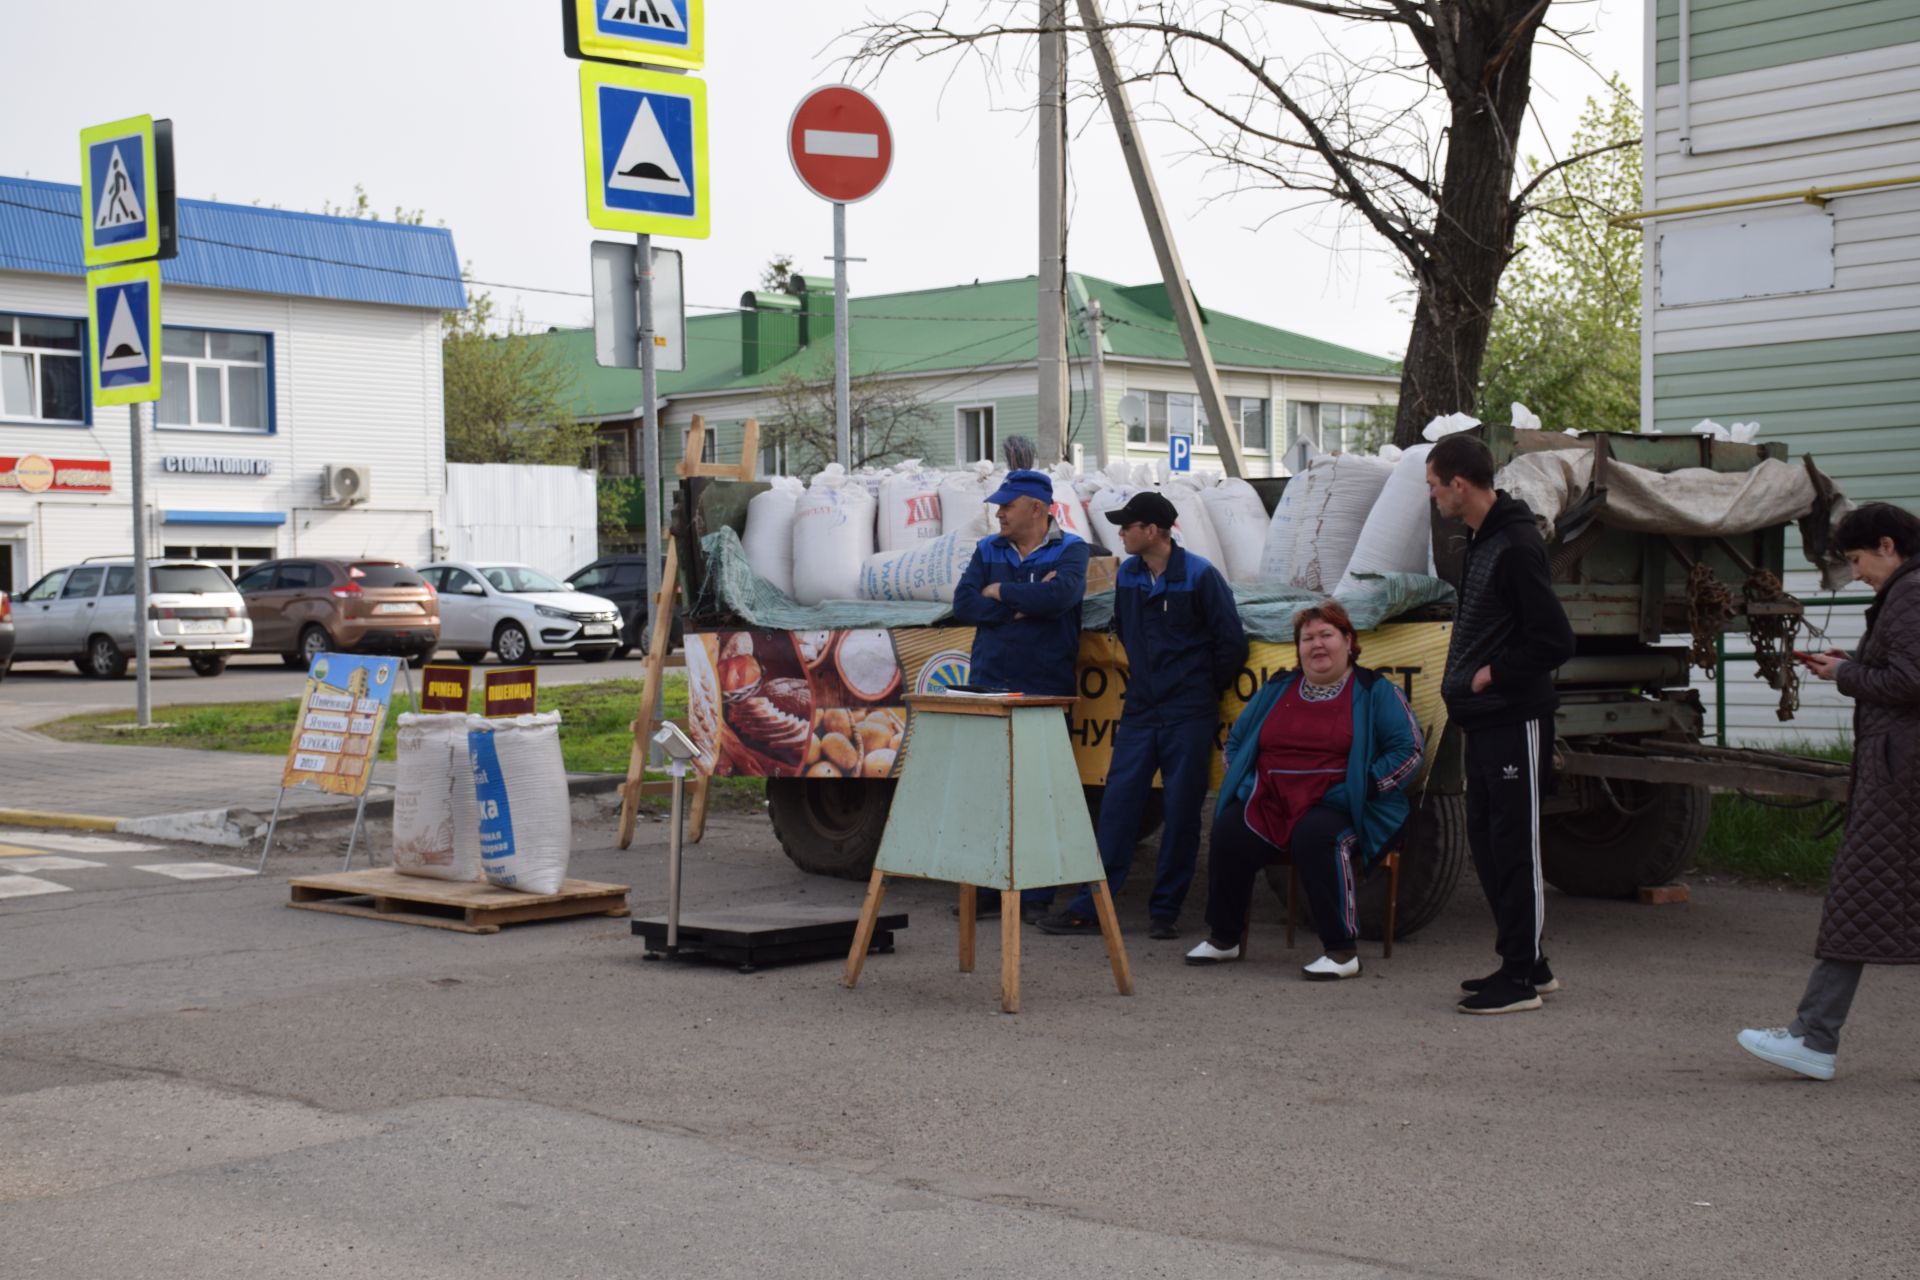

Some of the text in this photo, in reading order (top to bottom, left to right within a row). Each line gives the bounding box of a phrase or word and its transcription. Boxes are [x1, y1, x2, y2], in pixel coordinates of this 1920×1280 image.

[1174, 438, 1188, 468] P
[164, 455, 272, 476] СТОМАТОЛОГИЯ
[428, 681, 464, 698] ЯЧМЕНЬ
[488, 682, 532, 702] ПШЕНИЦА
[312, 694, 351, 710] Пшеница
[309, 716, 342, 730] Ячмень
[301, 734, 342, 750] УРОЖАЙ
